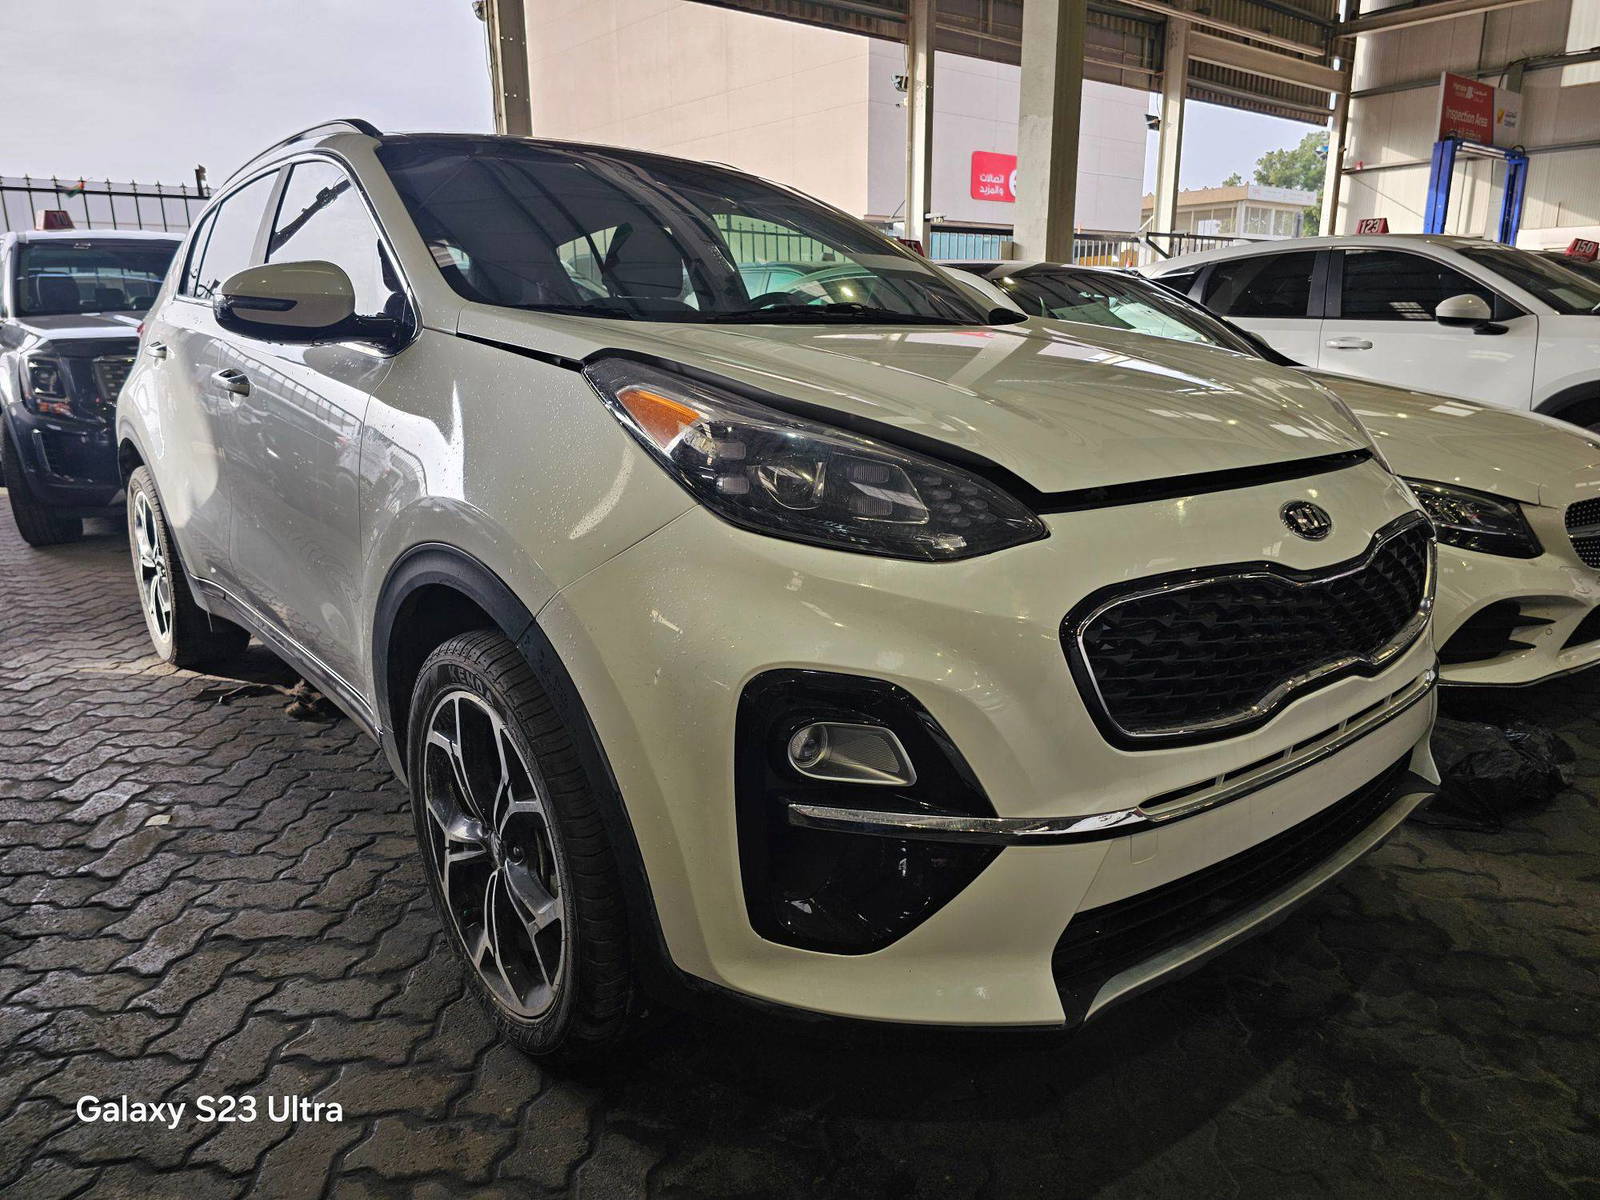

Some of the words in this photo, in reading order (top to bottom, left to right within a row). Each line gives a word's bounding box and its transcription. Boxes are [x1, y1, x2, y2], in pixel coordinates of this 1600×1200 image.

[1445, 105, 1475, 126] Inspection
[1474, 113, 1488, 128] Area
[1360, 219, 1380, 234] 123
[1575, 239, 1594, 254] 150
